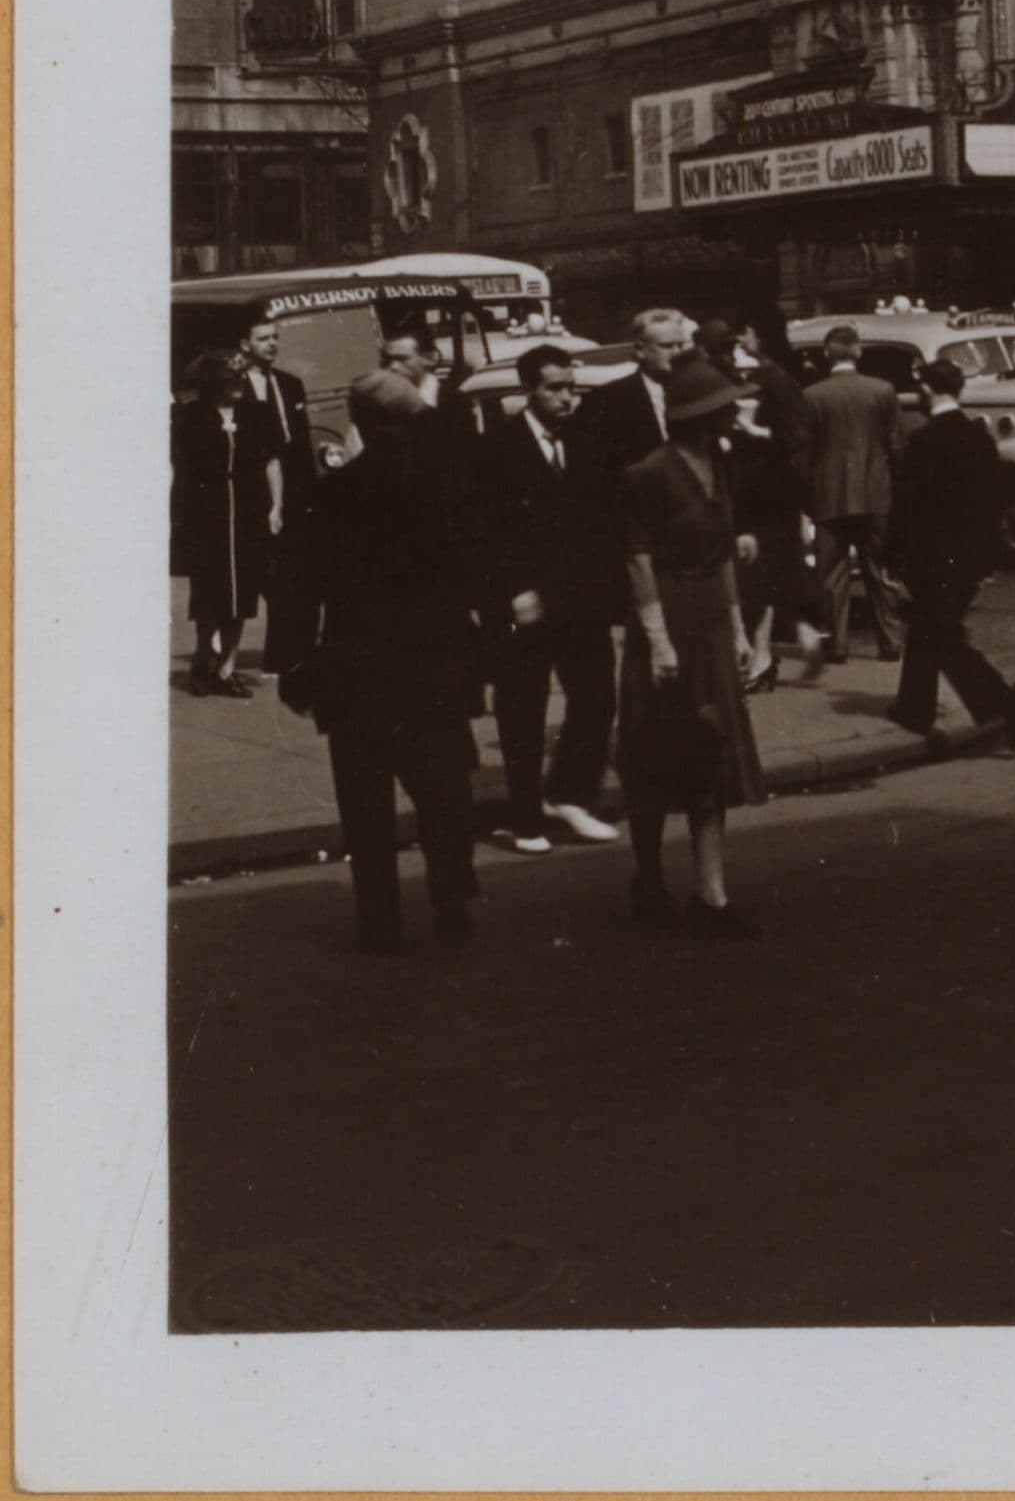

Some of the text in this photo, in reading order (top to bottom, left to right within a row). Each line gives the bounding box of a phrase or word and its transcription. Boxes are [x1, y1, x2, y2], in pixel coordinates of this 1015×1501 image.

[683, 156, 770, 199] NOW RENTING
[826, 135, 928, 185] Capacity 6000 Seats
[266, 286, 378, 319] DUVERNOY
[383, 282, 458, 299] BAKERS
